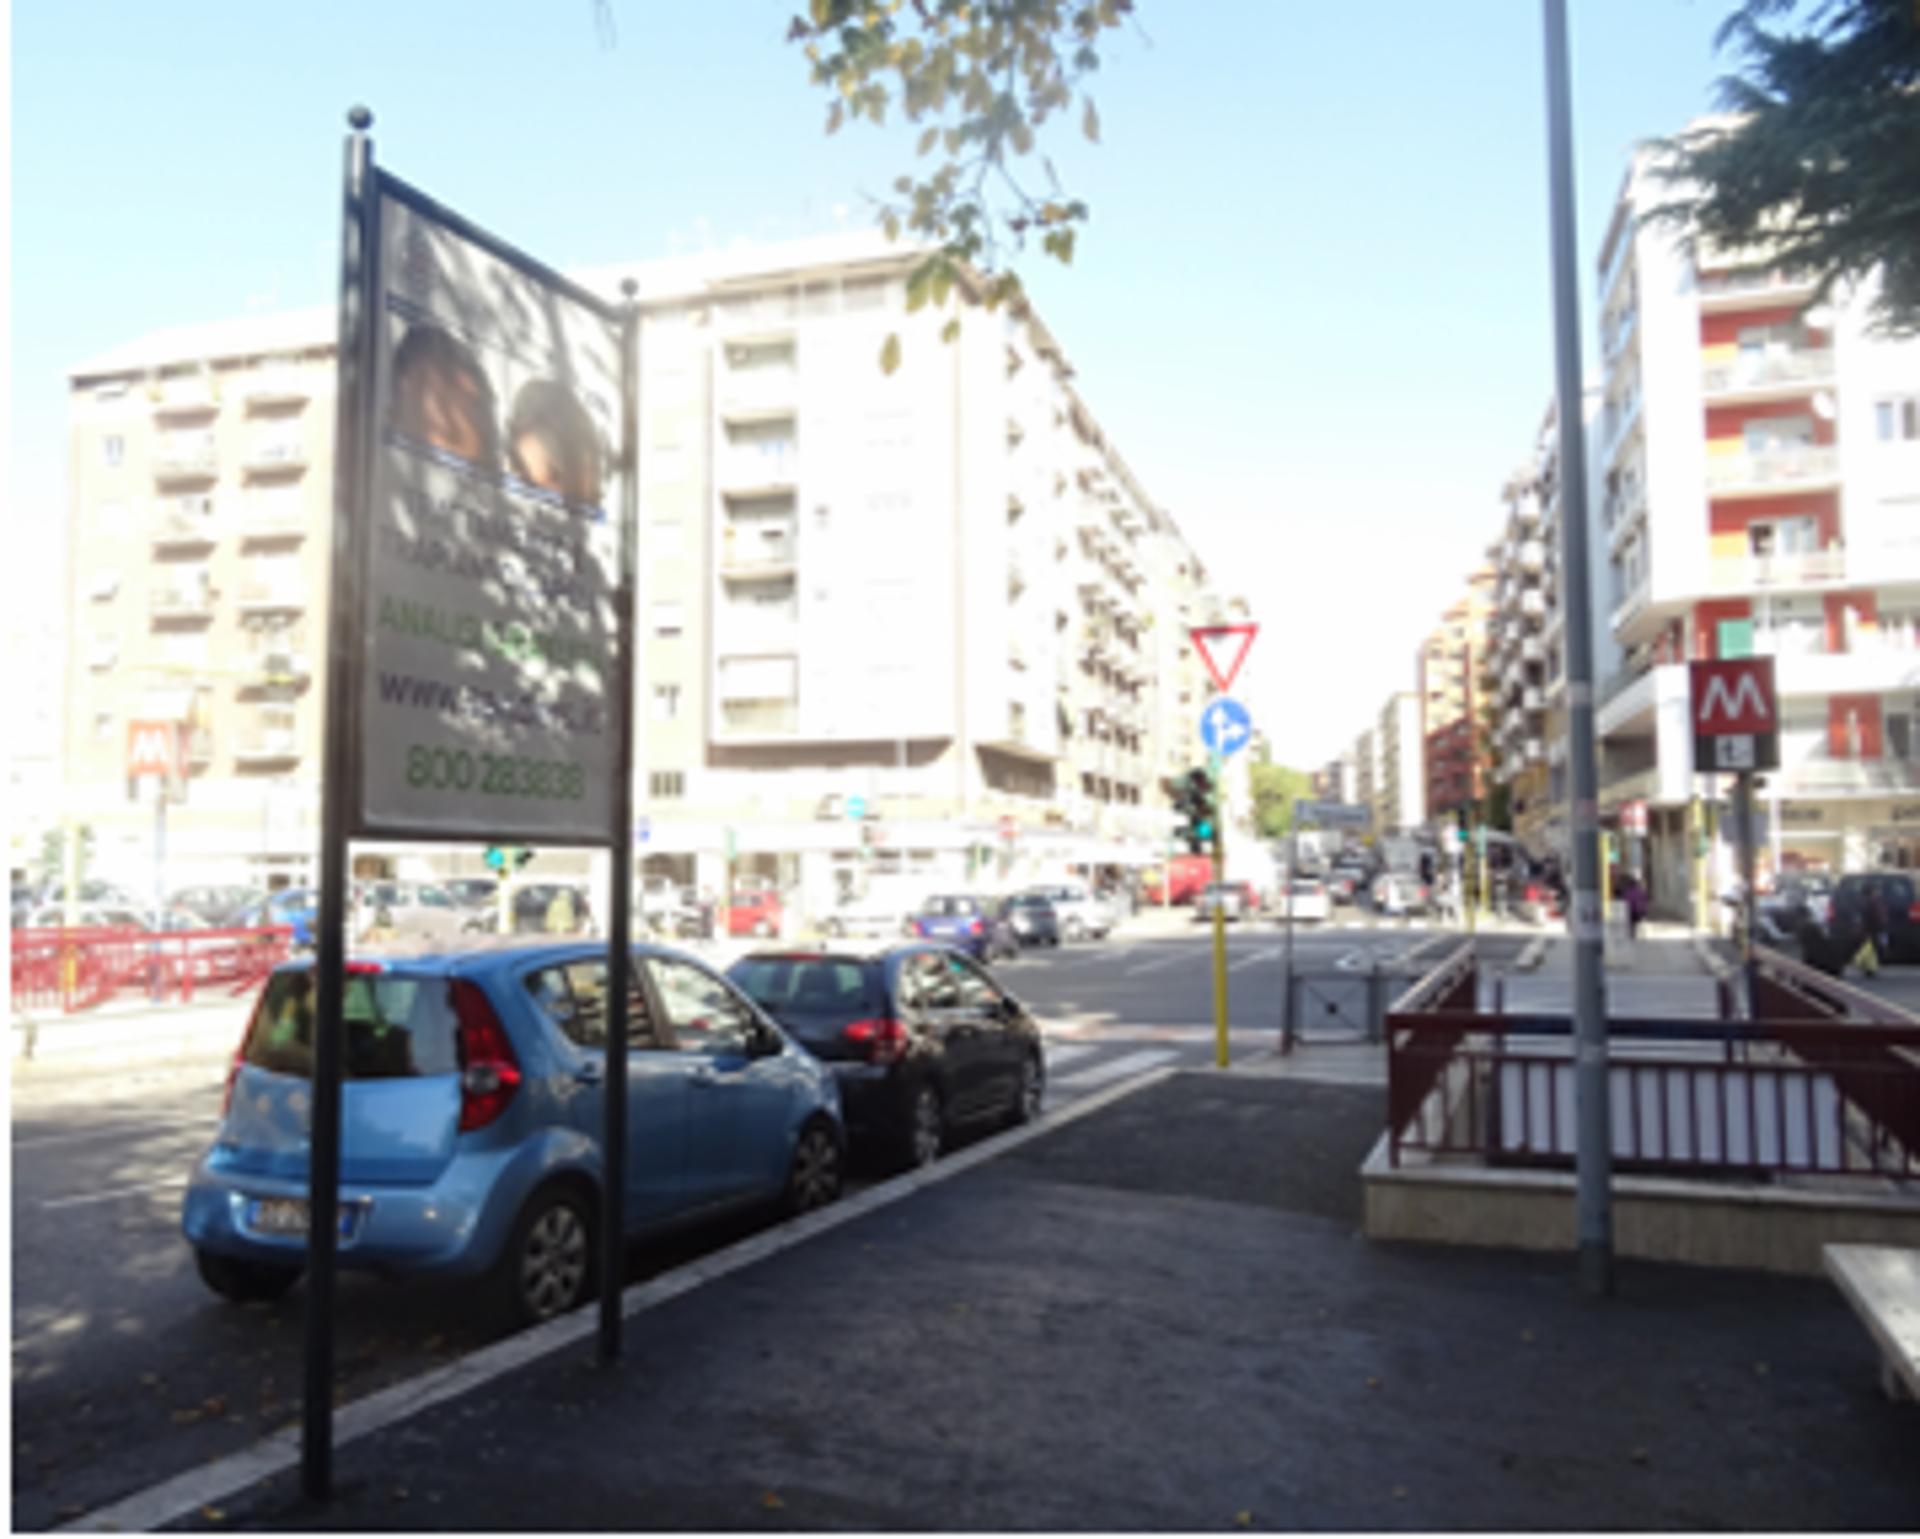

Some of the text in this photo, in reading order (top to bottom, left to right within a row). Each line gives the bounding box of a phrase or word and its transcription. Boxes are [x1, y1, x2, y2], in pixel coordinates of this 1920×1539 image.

[1699, 672, 1768, 720] M
[130, 728, 170, 764] M
[406, 745, 473, 791] 800
